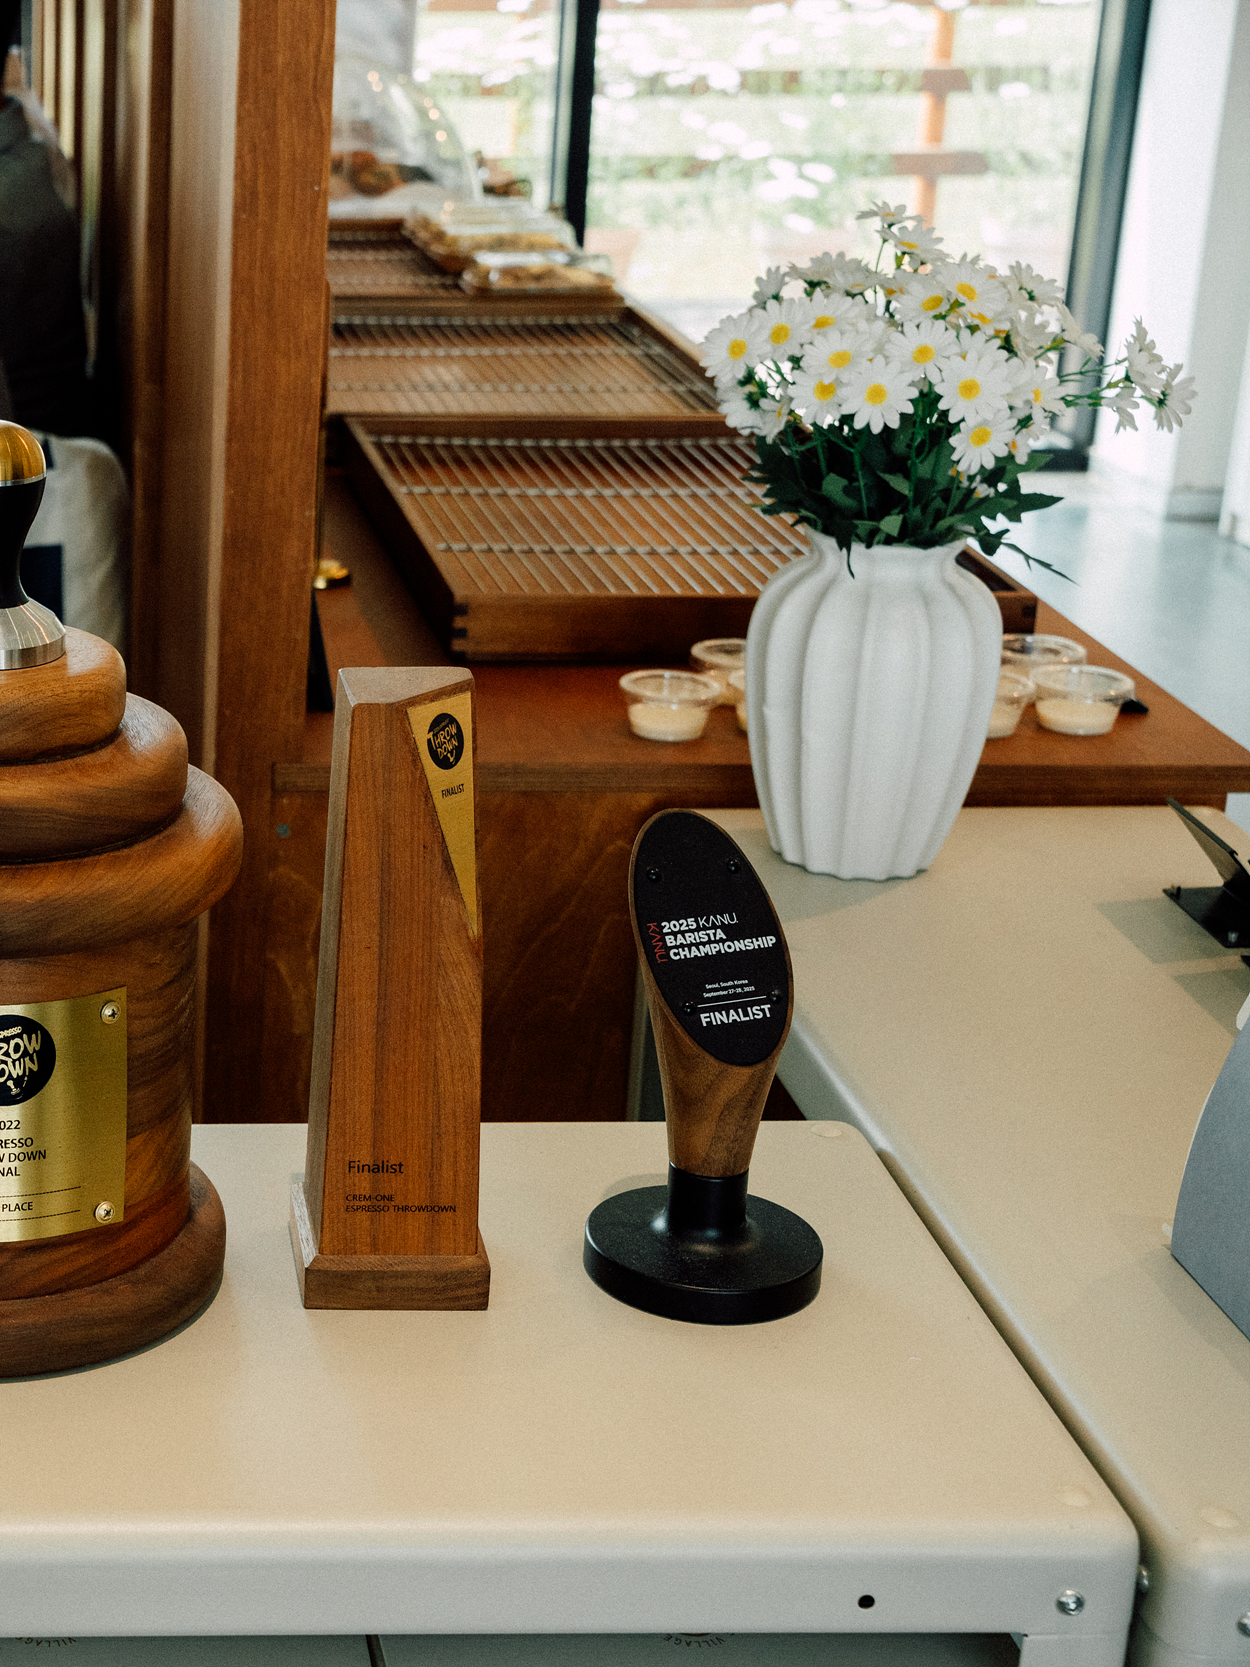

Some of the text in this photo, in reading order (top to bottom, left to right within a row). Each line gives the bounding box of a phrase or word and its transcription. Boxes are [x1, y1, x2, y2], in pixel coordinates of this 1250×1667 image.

[427, 722, 457, 750] THROW
[437, 736, 458, 760] DOWN
[441, 783, 465, 798] FINALIST
[661, 918, 697, 933] 2025
[664, 928, 727, 947] BARISTA
[669, 935, 777, 961] CHAMPIONSHIP
[703, 990, 728, 998] September
[700, 1004, 771, 1027] FINALIST
[8, 1149, 47, 1163] DOWN
[348, 1160, 404, 1174] Finalist
[345, 1194, 395, 1202] CREM-ONE
[2, 1201, 34, 1212] PLACE
[345, 1204, 457, 1213] ESPRESSO THROWDOWN
